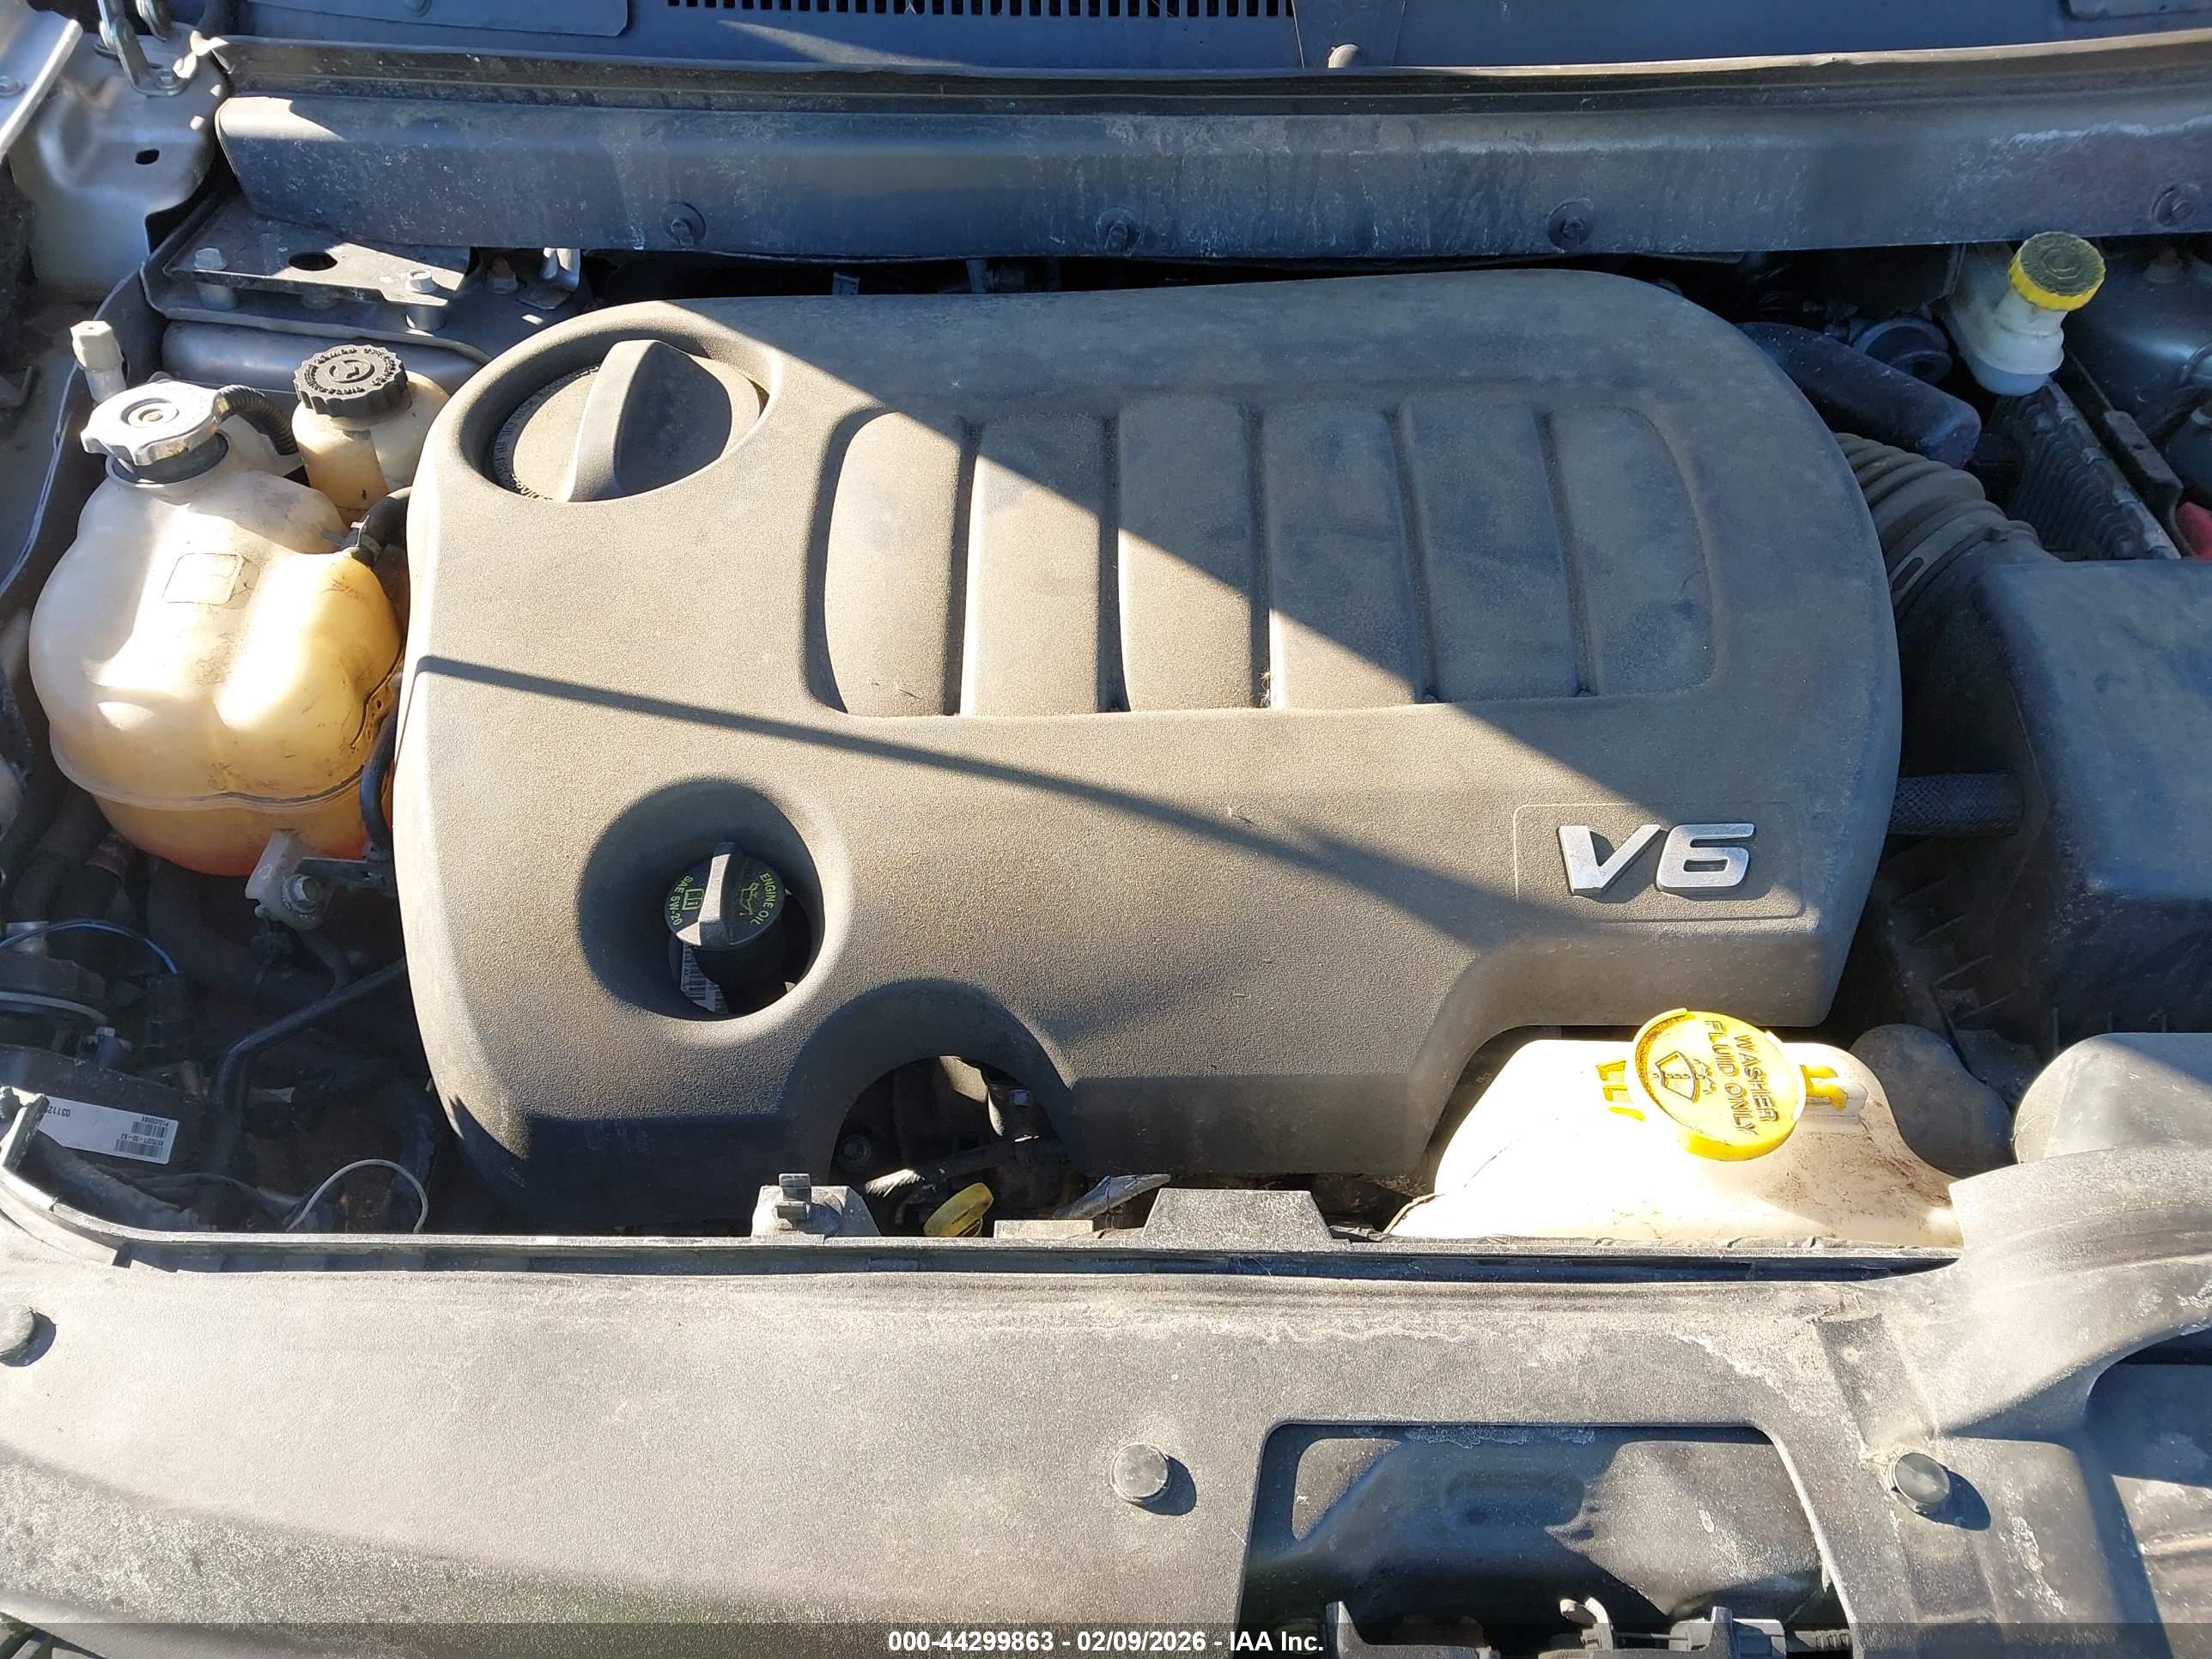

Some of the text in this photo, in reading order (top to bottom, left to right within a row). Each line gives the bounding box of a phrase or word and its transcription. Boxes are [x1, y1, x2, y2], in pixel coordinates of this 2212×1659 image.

[1559, 823, 1755, 896] V6
[669, 874, 694, 926] SAE 5W-20
[750, 872, 777, 926] ENGINE OIL
[1703, 1020, 1759, 1135] FLUID ONLY
[1734, 1034, 1780, 1122] WASHER
